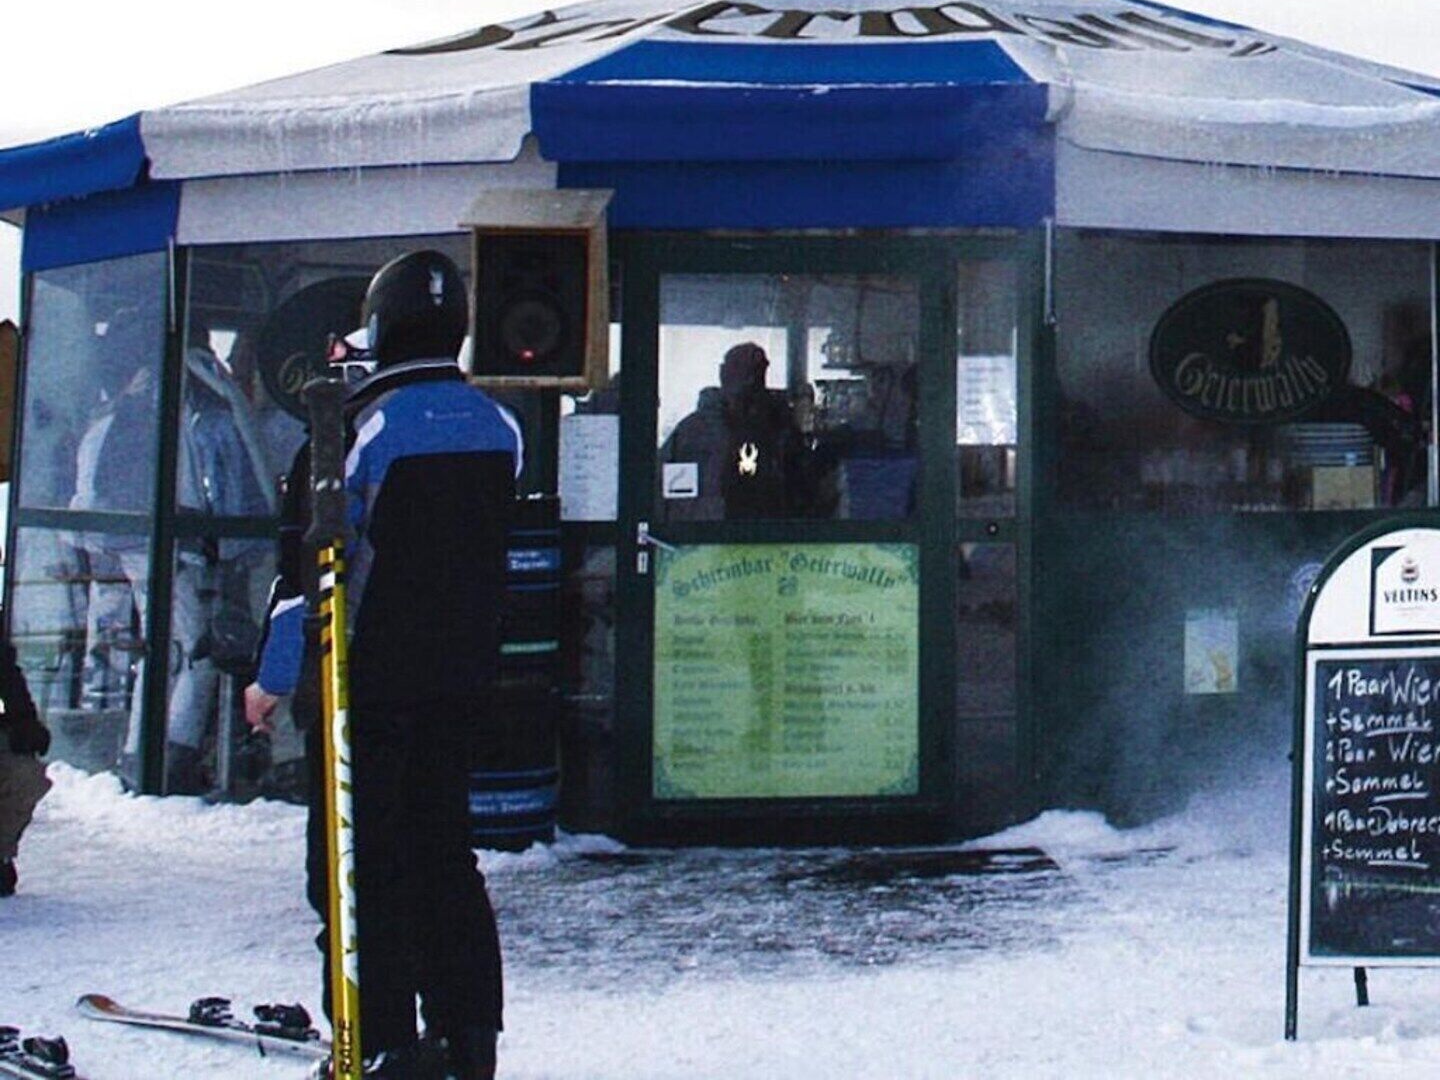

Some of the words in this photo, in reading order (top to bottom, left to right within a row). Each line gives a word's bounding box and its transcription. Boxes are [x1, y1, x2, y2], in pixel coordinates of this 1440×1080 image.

[1383, 588, 1439, 604] VELTINS
[1328, 670, 1342, 700] 1
[1347, 670, 1390, 697] Paar
[1338, 737, 1376, 762] Paar
[1337, 808, 1375, 833] Paar
